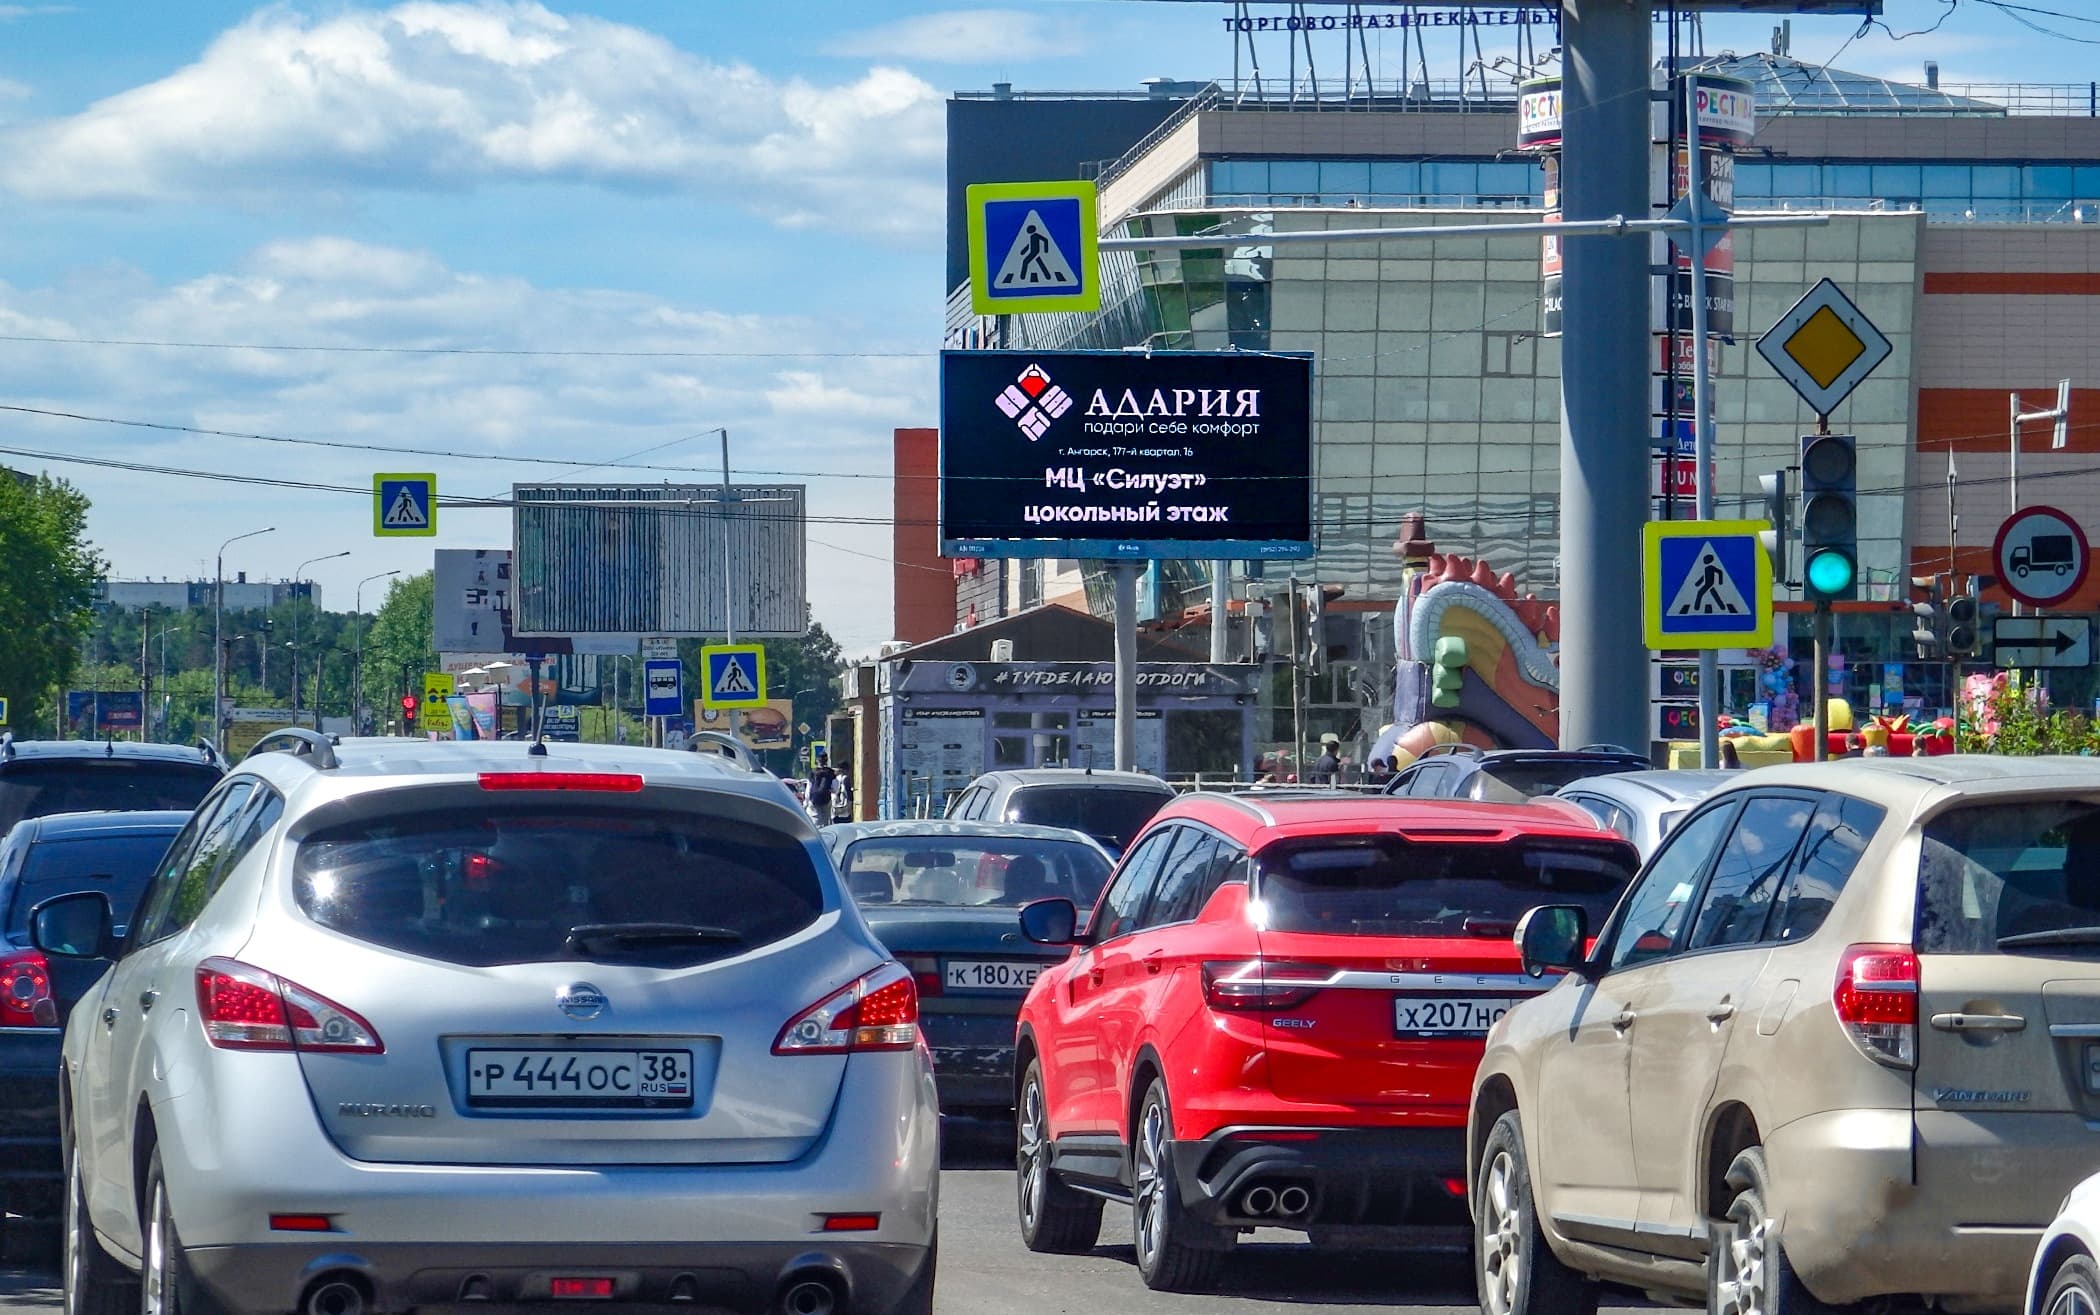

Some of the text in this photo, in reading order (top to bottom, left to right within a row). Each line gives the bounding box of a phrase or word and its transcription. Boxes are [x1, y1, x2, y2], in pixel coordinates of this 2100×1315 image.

[1085, 388, 1260, 420] АДАРИЯ
[1084, 421, 1260, 437] подари себе комфорт
[1183, 447, 1194, 457] 16
[1045, 467, 1207, 494] МЦ «Силуэт»
[1024, 500, 1229, 524] цокольный этаж
[1389, 974, 1528, 986] GEEL
[560, 995, 603, 1004] NISSAN
[1272, 1018, 1317, 1029] GEELY
[643, 1056, 677, 1082] 38
[641, 1082, 667, 1093] RUS
[338, 1102, 436, 1118] MURANO
